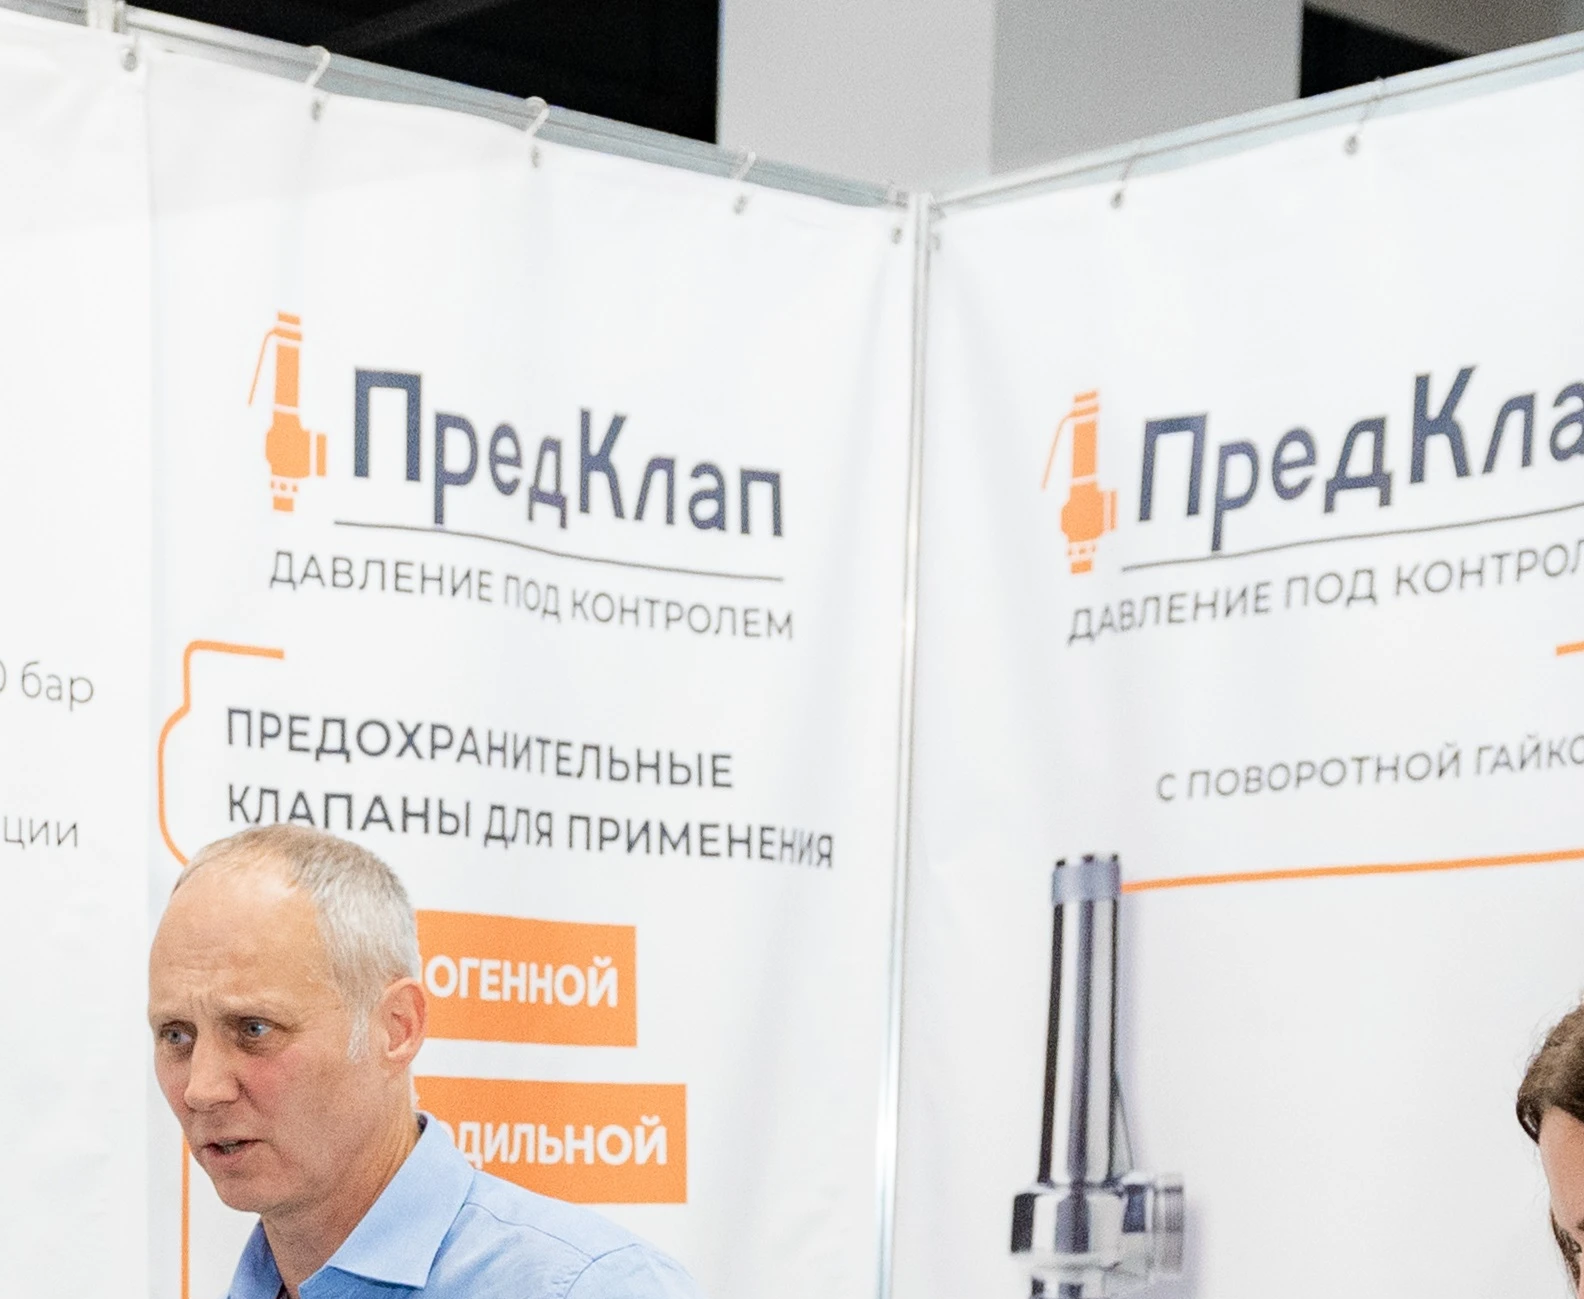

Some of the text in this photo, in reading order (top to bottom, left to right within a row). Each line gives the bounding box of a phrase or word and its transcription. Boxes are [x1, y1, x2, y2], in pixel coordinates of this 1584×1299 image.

[353, 367, 784, 538] ПредКлап
[269, 549, 793, 640] ДАВЛЕНИЕ ПОД КОНТРОЛЕМ
[1066, 580, 1272, 646] ДАВЛЕНИЕ
[1285, 567, 1378, 608] ПОД
[20, 660, 95, 712] бар
[227, 707, 733, 789] ПРЕДОХРАНИТЕЛЬНЫЕ
[1156, 772, 1176, 803] С
[1187, 742, 1462, 798] ПОВОРОТНОЙ
[228, 783, 834, 868] КЛАПАНЫ ДЛЯ ПРИМЕНЕНИЯ
[420, 955, 619, 1009] ОГЕННОЙ
[443, 1115, 668, 1169] ДИЛЬНОЙ
